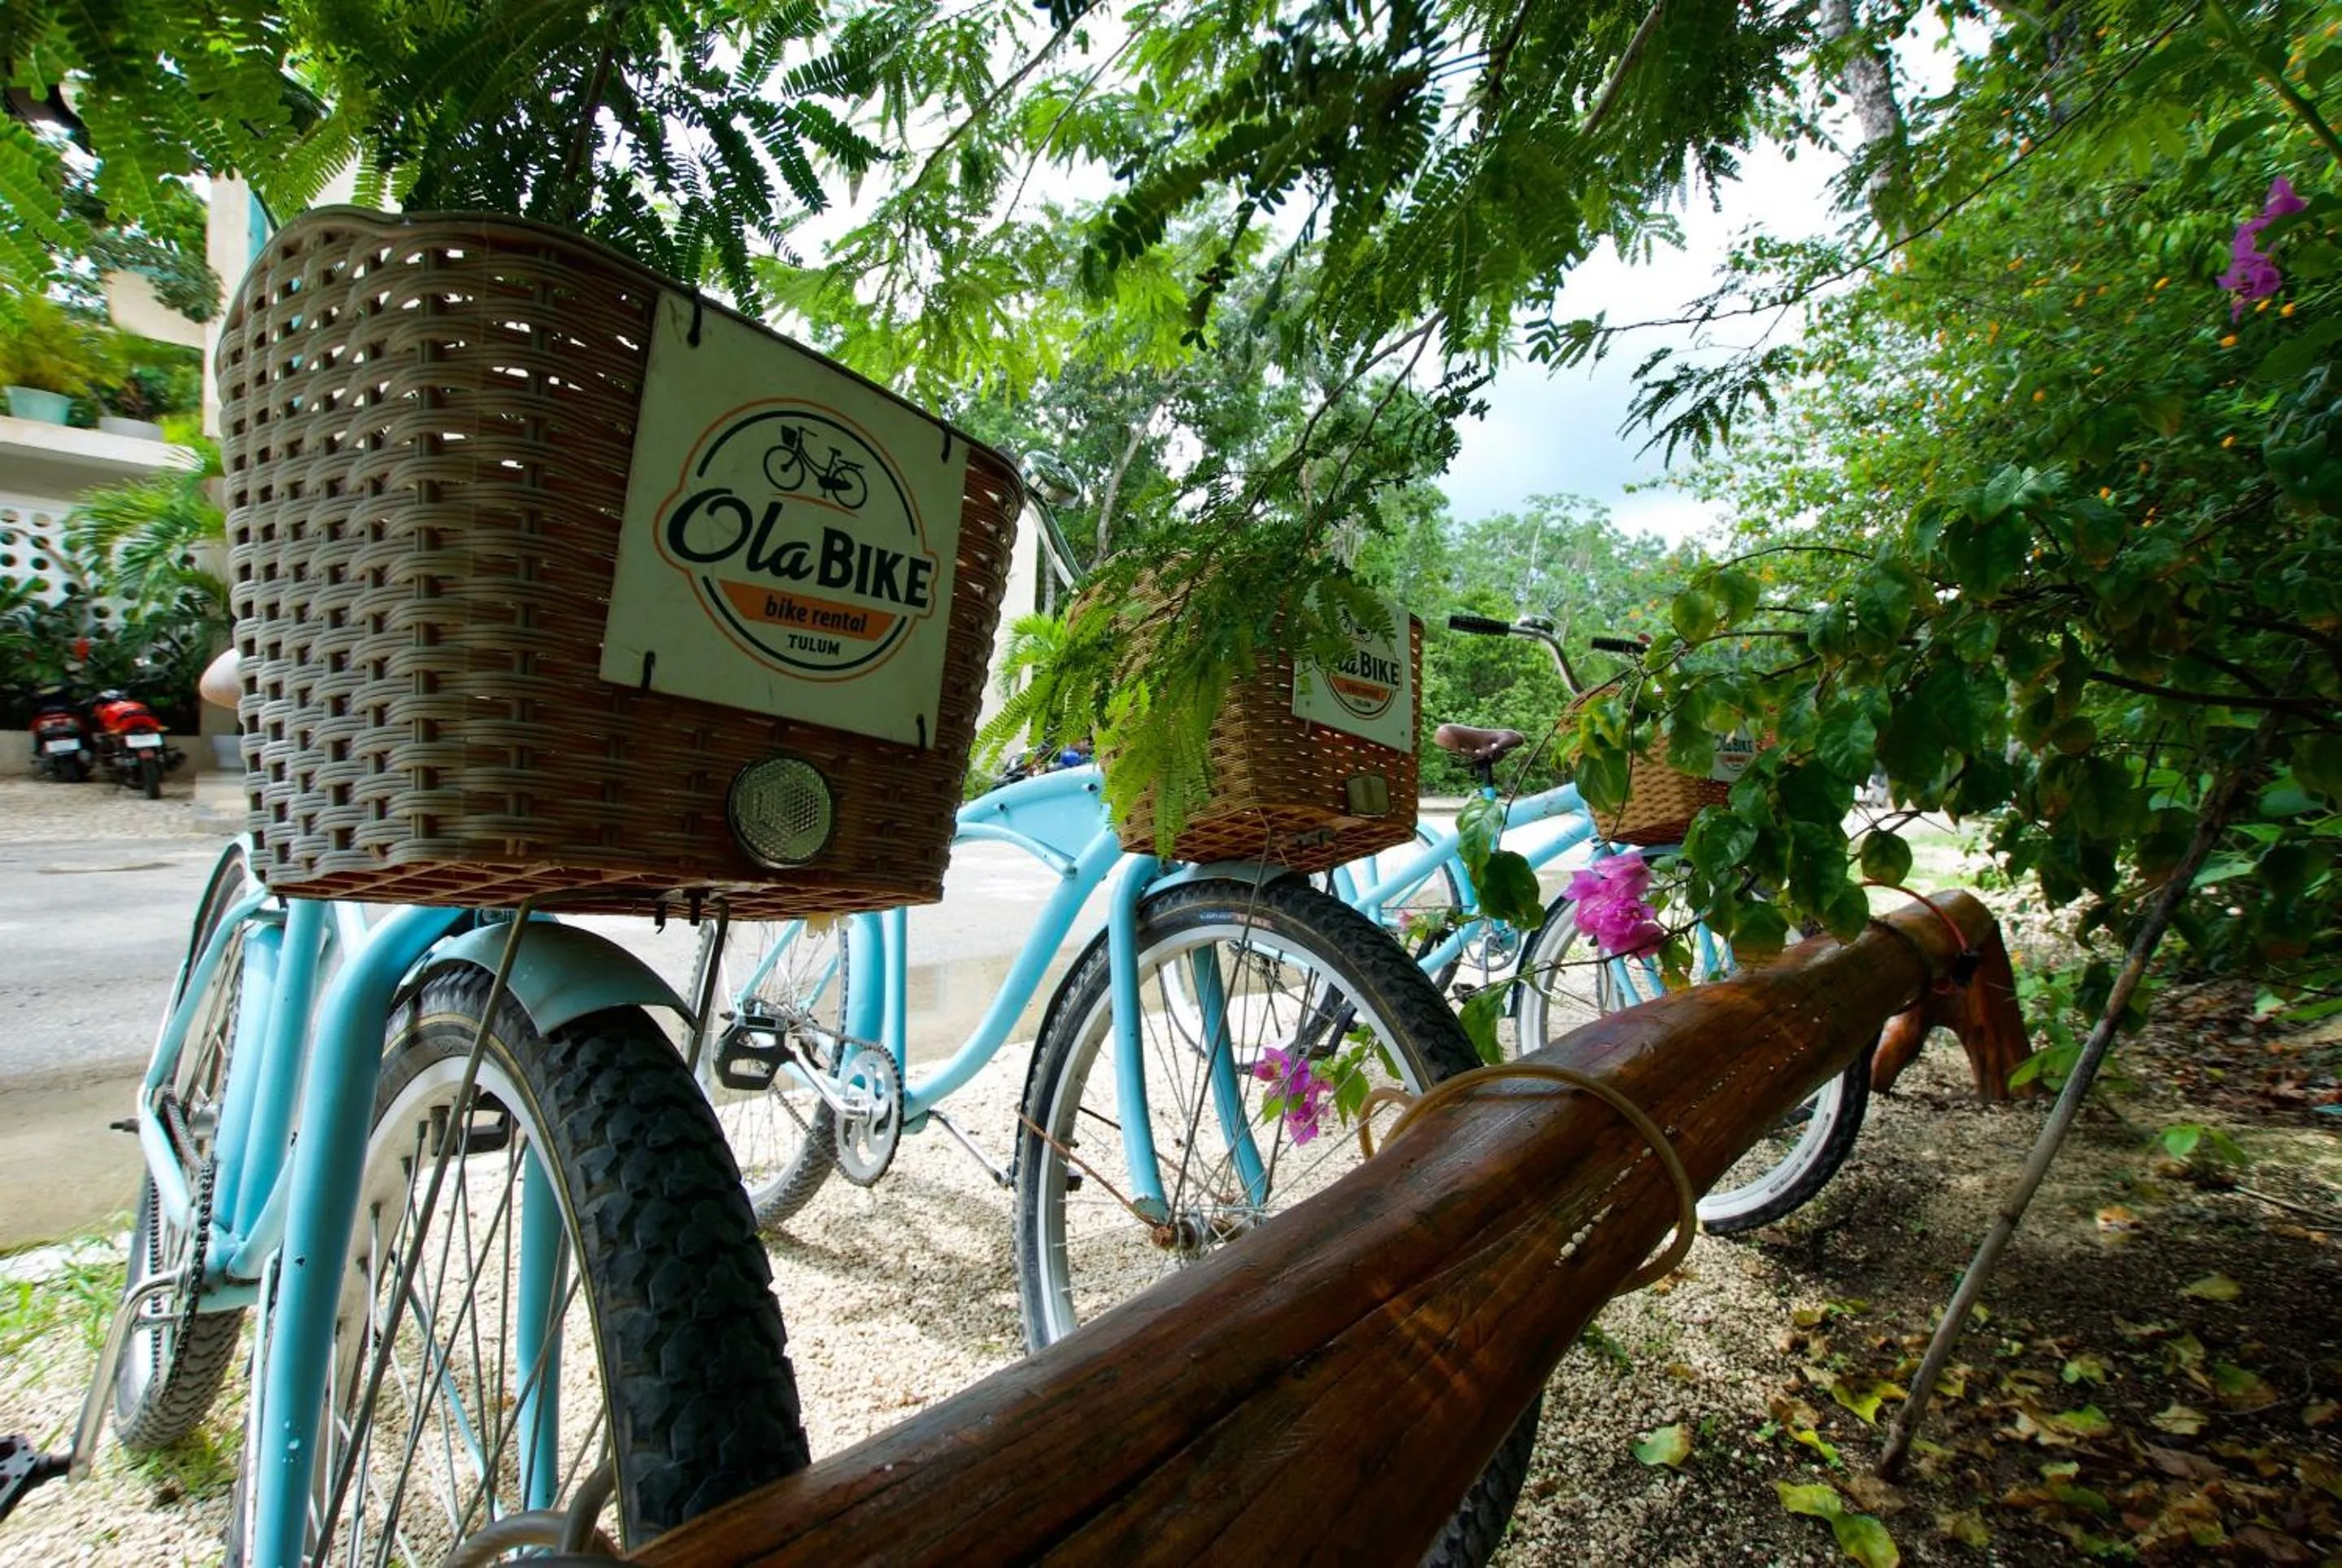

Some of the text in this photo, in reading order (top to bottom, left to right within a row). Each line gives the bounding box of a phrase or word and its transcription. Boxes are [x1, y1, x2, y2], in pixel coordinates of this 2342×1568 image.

[764, 595, 868, 634] bike rental
[787, 633, 841, 656] TULUM
